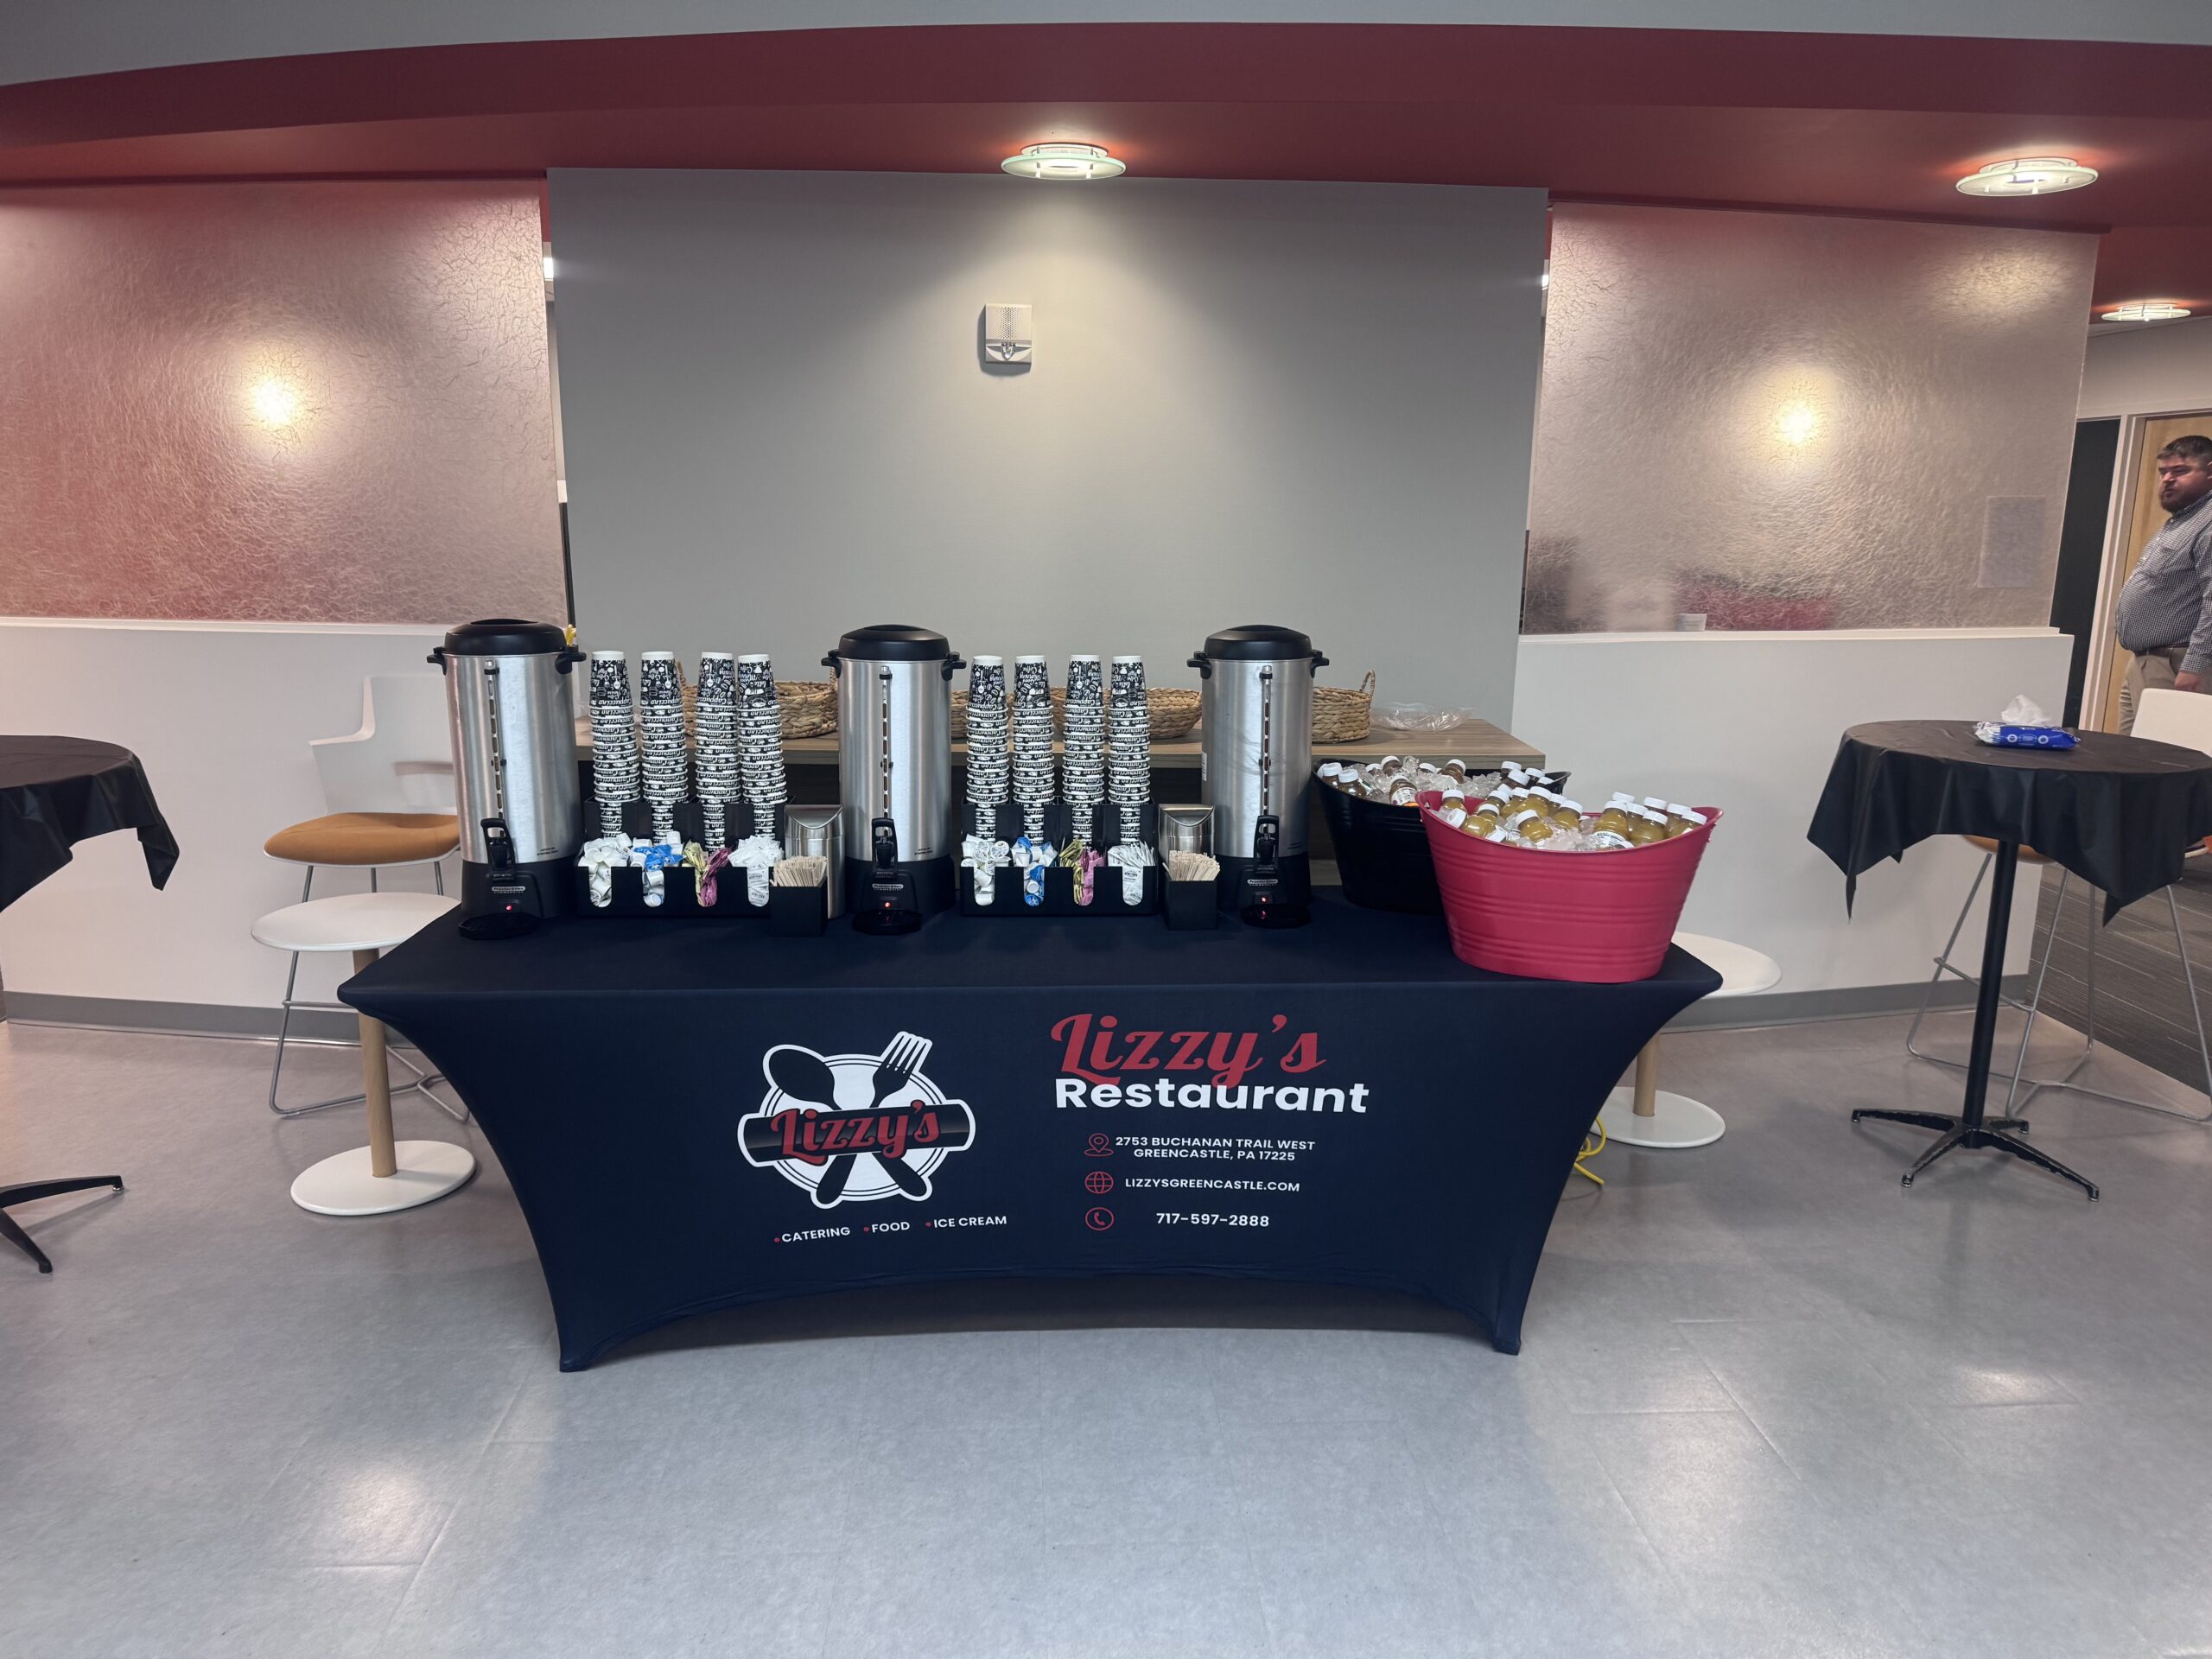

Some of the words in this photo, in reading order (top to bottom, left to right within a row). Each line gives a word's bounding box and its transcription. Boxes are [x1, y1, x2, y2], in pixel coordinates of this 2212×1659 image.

[1023, 665, 1037, 674] Coffee
[1051, 1014, 1327, 1090] Lizzy's
[1056, 1078, 1369, 1112] Restaurant
[770, 1100, 941, 1166] Lizzy's
[1115, 1136, 1148, 1147] 2753
[1151, 1136, 1232, 1148] BUCHANAN
[1236, 1138, 1274, 1150] TRAIL
[1276, 1139, 1316, 1151] WEST
[1134, 1147, 1234, 1160] GREENCASTLE,
[1236, 1149, 1255, 1160] PA
[1258, 1149, 1297, 1161] 17225
[1124, 1178, 1300, 1192] LIZZYSGREENCASTLE.COM
[1155, 1212, 1270, 1228] 717-597-2888
[781, 1225, 851, 1243] CATERING
[871, 1221, 911, 1233] FOOD
[933, 1217, 956, 1229] ICE
[958, 1216, 1007, 1228] CREAM
